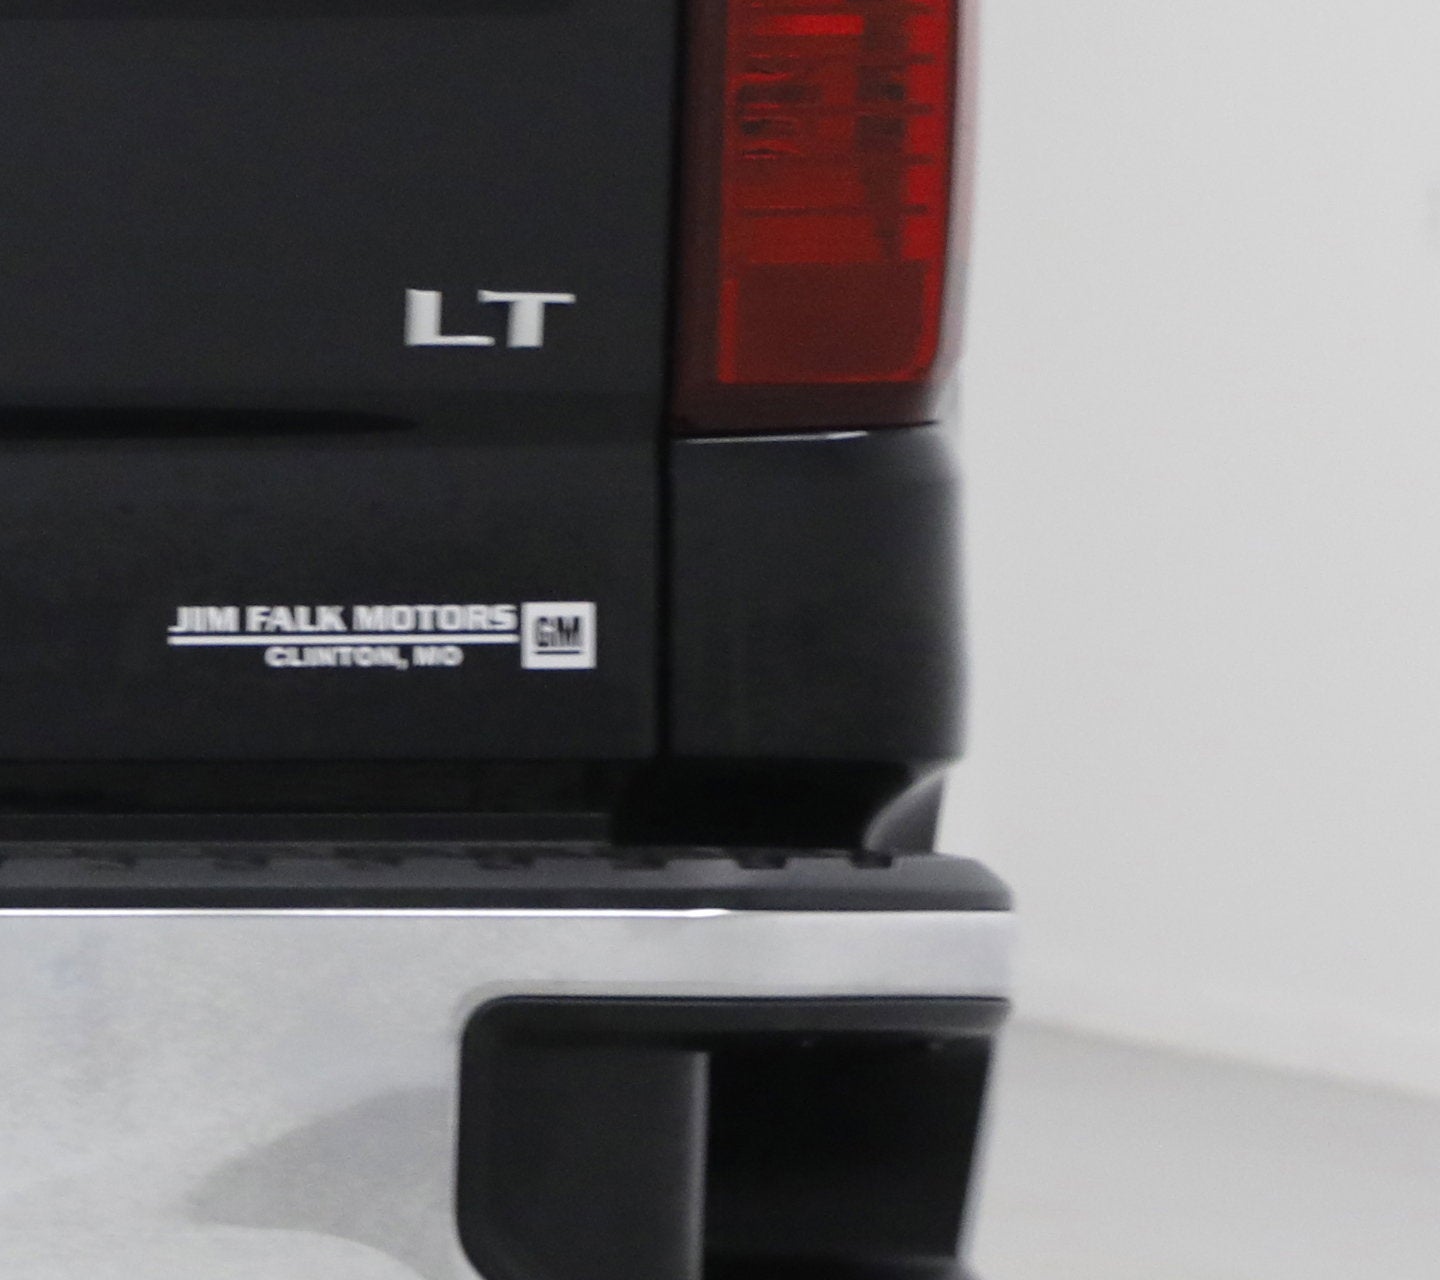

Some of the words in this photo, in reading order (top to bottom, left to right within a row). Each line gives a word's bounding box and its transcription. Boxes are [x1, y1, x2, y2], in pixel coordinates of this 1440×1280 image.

[404, 288, 576, 348] LT
[169, 605, 240, 633] JIM
[244, 605, 347, 632] FALK
[352, 604, 519, 632] MOTORS
[534, 615, 583, 648] GM
[264, 646, 409, 671] CLINTON,
[412, 644, 464, 667] MO
